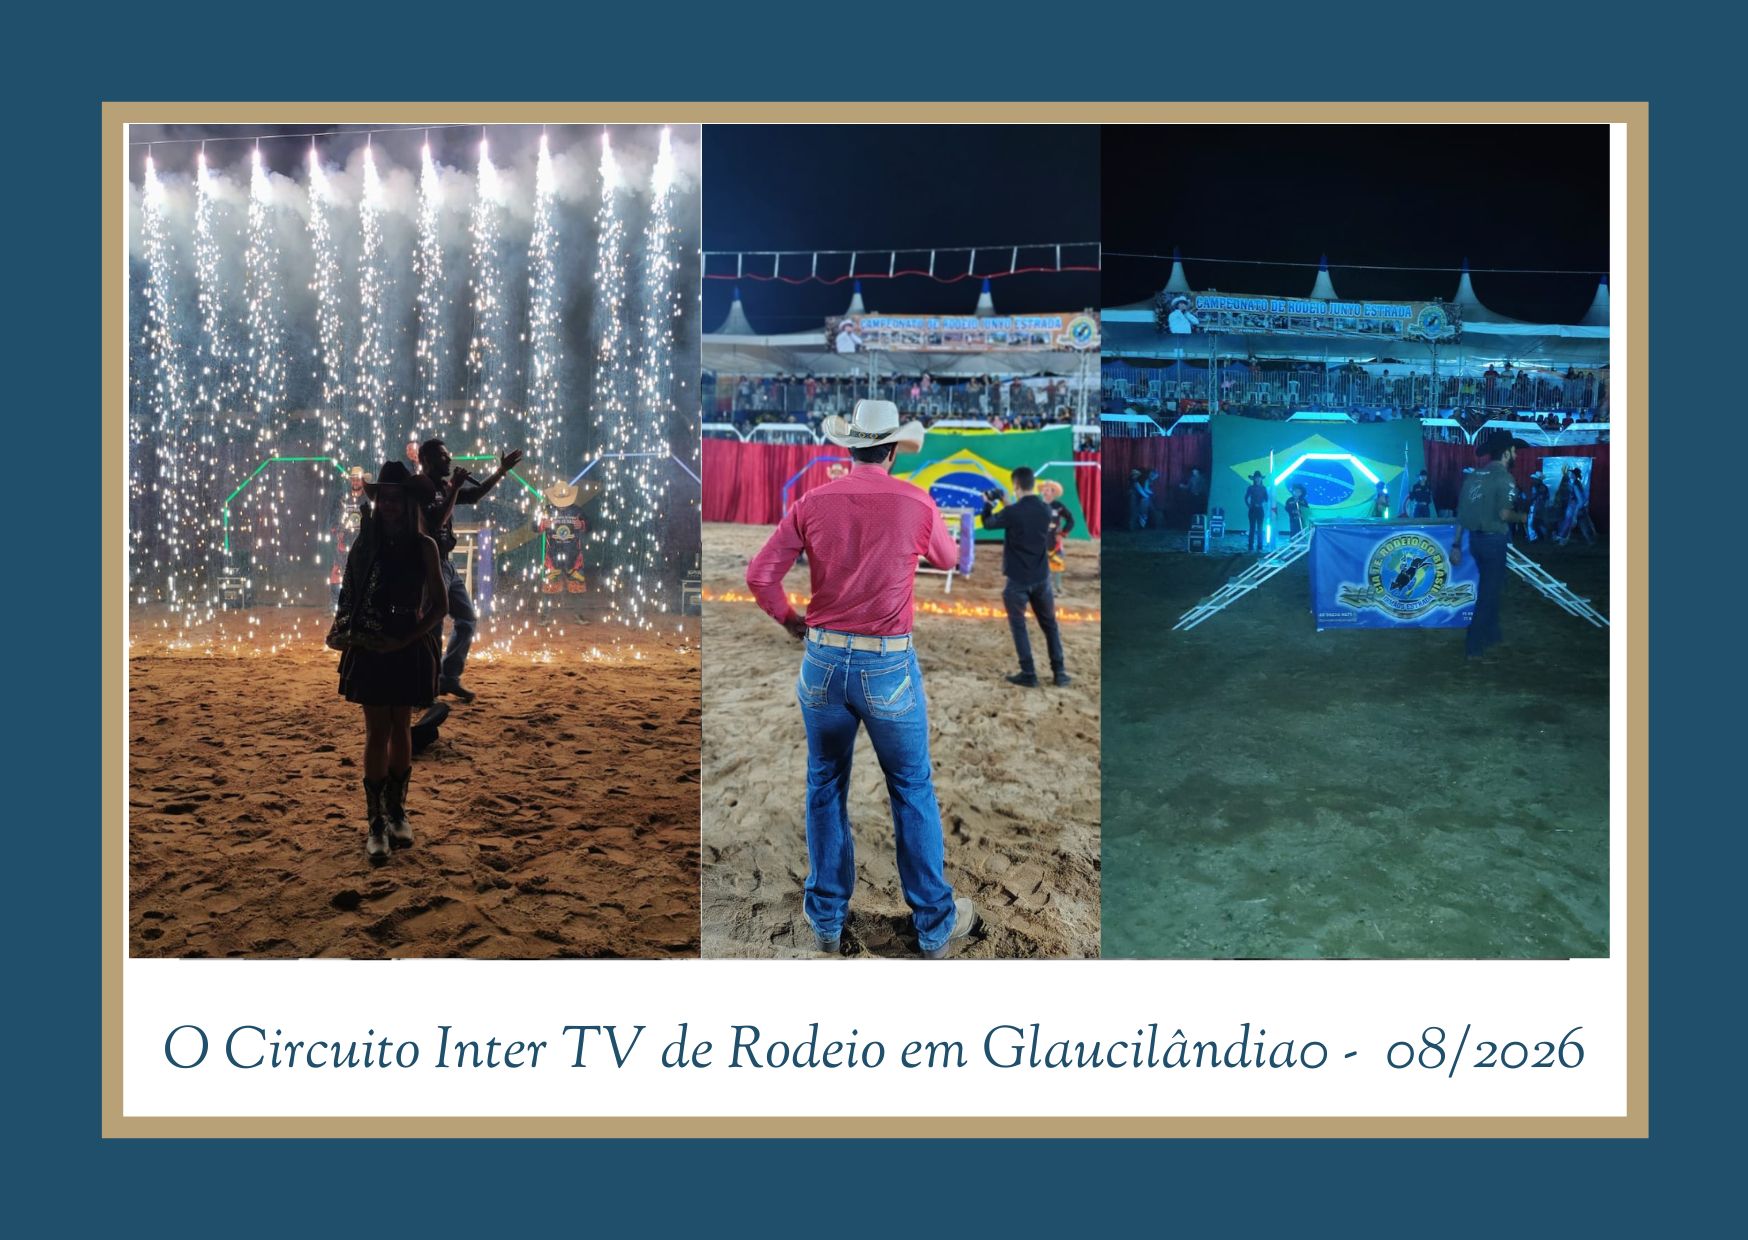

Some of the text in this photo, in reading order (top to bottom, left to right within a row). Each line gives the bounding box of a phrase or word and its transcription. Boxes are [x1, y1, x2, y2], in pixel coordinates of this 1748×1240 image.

[1196, 296, 1413, 318] CAMPEONATO DE RODEIO JUNYO ESTRADA
[861, 317, 923, 329] CAMPEONATO
